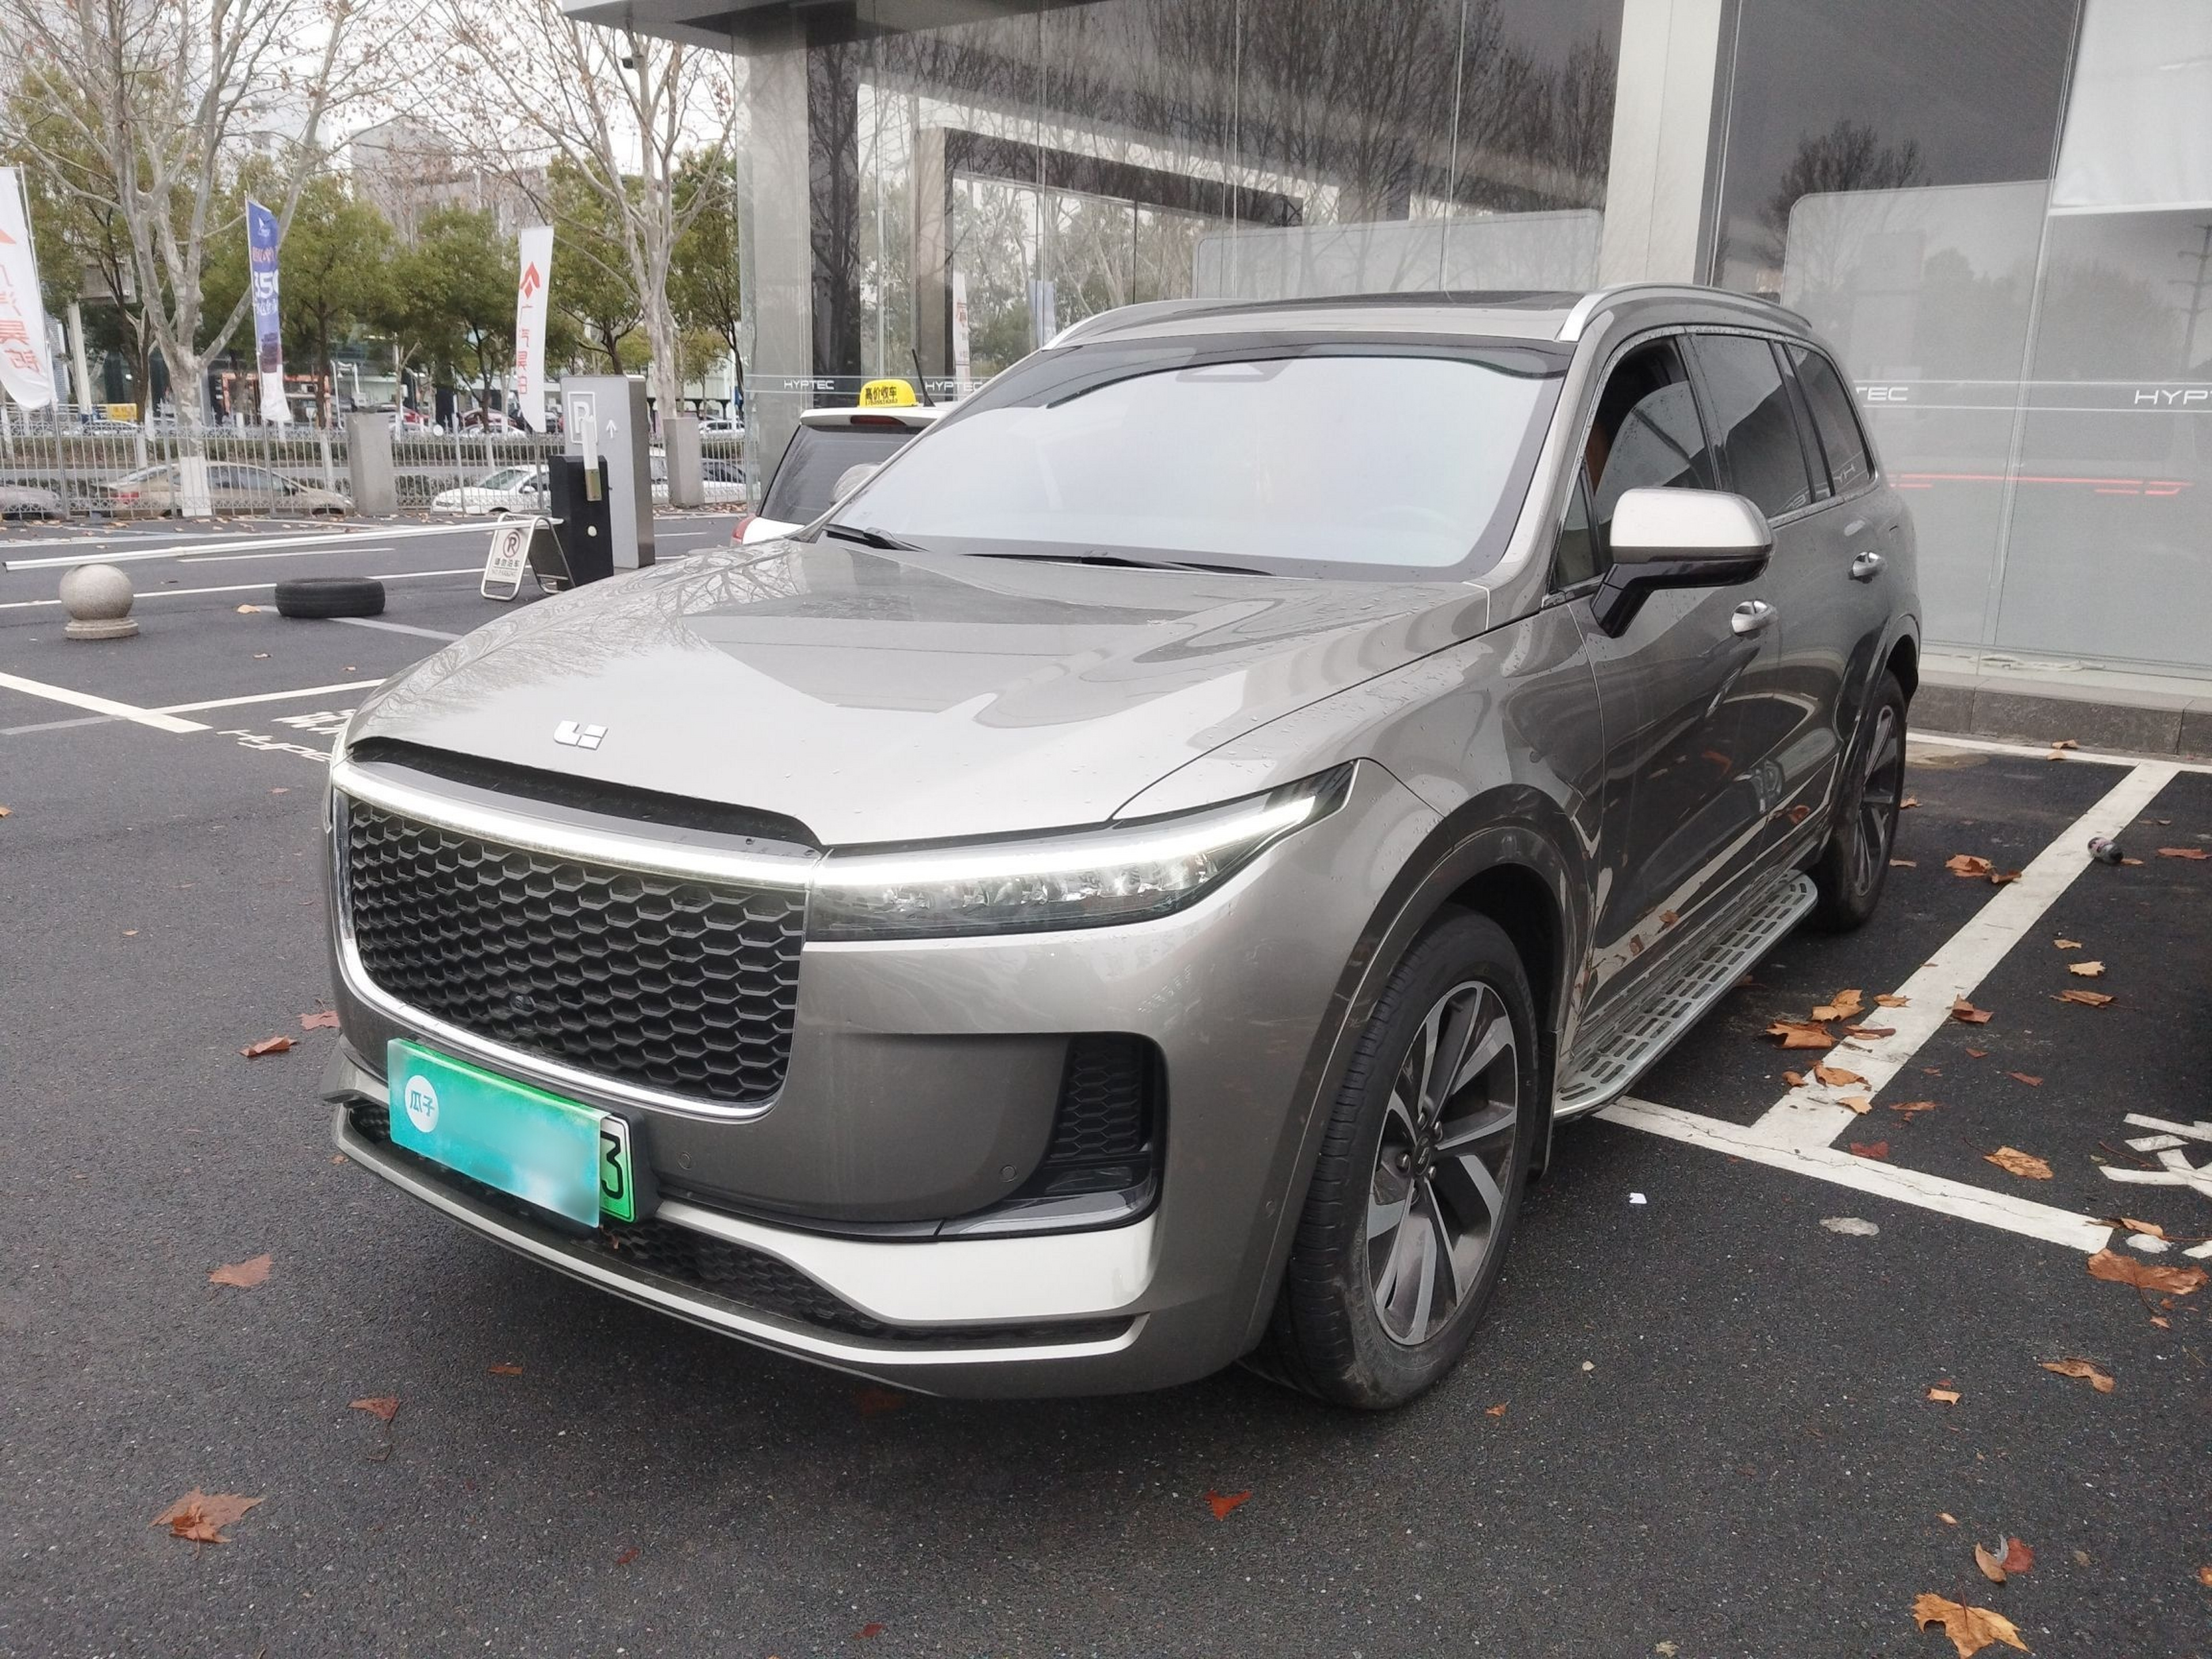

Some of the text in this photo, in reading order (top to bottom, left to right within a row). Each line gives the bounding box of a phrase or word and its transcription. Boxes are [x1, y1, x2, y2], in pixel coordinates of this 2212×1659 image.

[784, 380, 834, 390] HYPTEC
[925, 381, 983, 392] HYPTEC
[865, 385, 897, 400] 高价收车
[2135, 390, 2212, 404] HYP
[410, 1089, 435, 1118] 瓜子
[600, 1130, 624, 1200] 3
